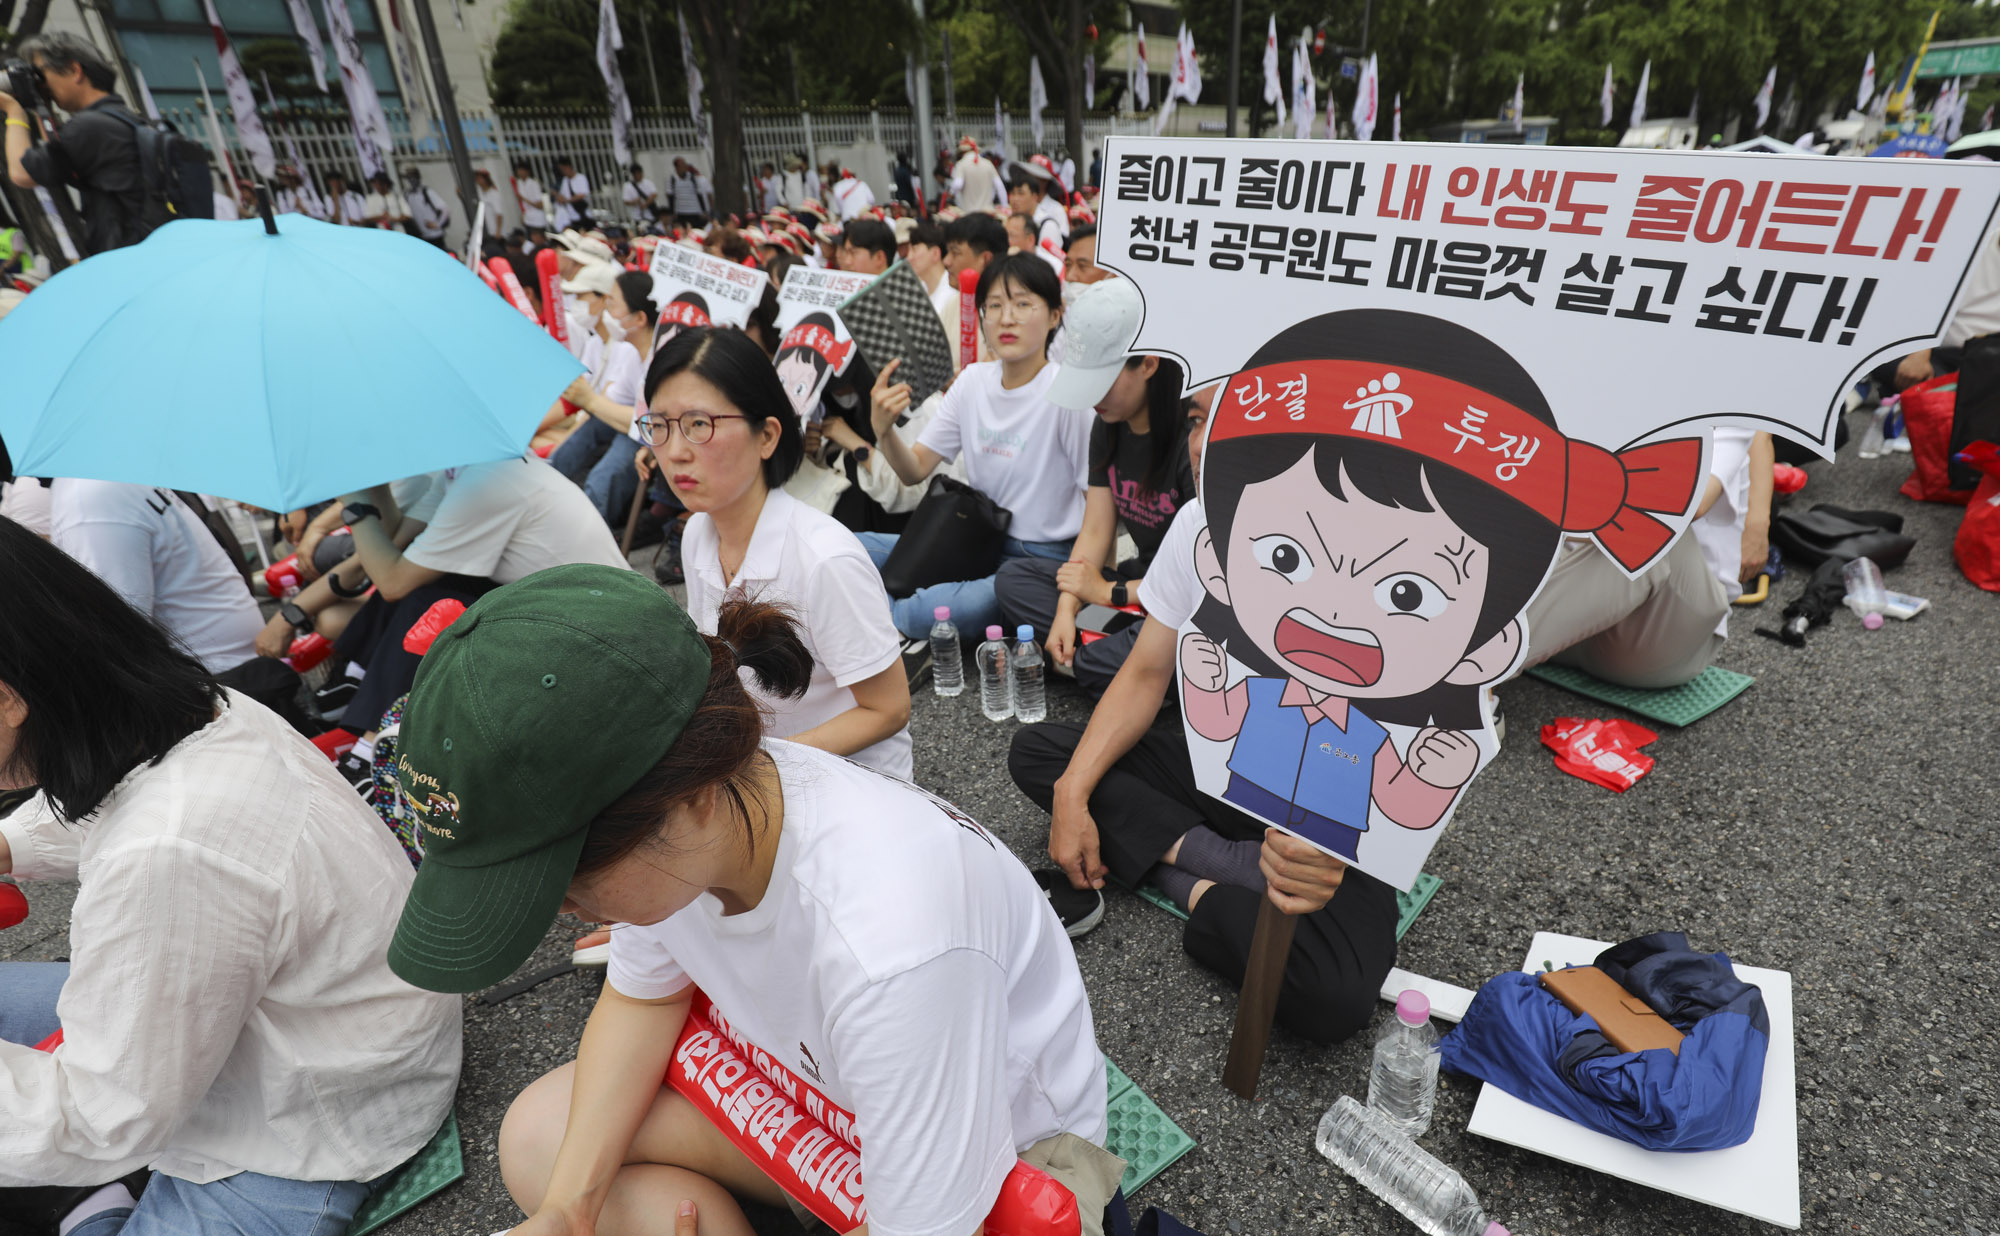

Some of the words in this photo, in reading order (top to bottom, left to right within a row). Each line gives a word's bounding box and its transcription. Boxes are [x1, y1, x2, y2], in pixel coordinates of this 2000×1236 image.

[1118, 154, 1226, 207] 줄이고
[1236, 158, 1366, 216] 줄이다
[1377, 163, 1431, 221] 내
[1440, 166, 1618, 236] 인생도
[1626, 175, 1961, 262] 줄어든다!
[1128, 215, 1199, 267] 청년
[1209, 221, 1377, 286] 공무원도
[1386, 236, 1547, 306] 마음껏
[1555, 252, 1688, 324] 살고
[1695, 266, 1879, 347] 싶다!
[1234, 373, 1308, 421] 단결
[1443, 404, 1541, 481] 투쟁
[677, 1030, 804, 1160] 정액인상
